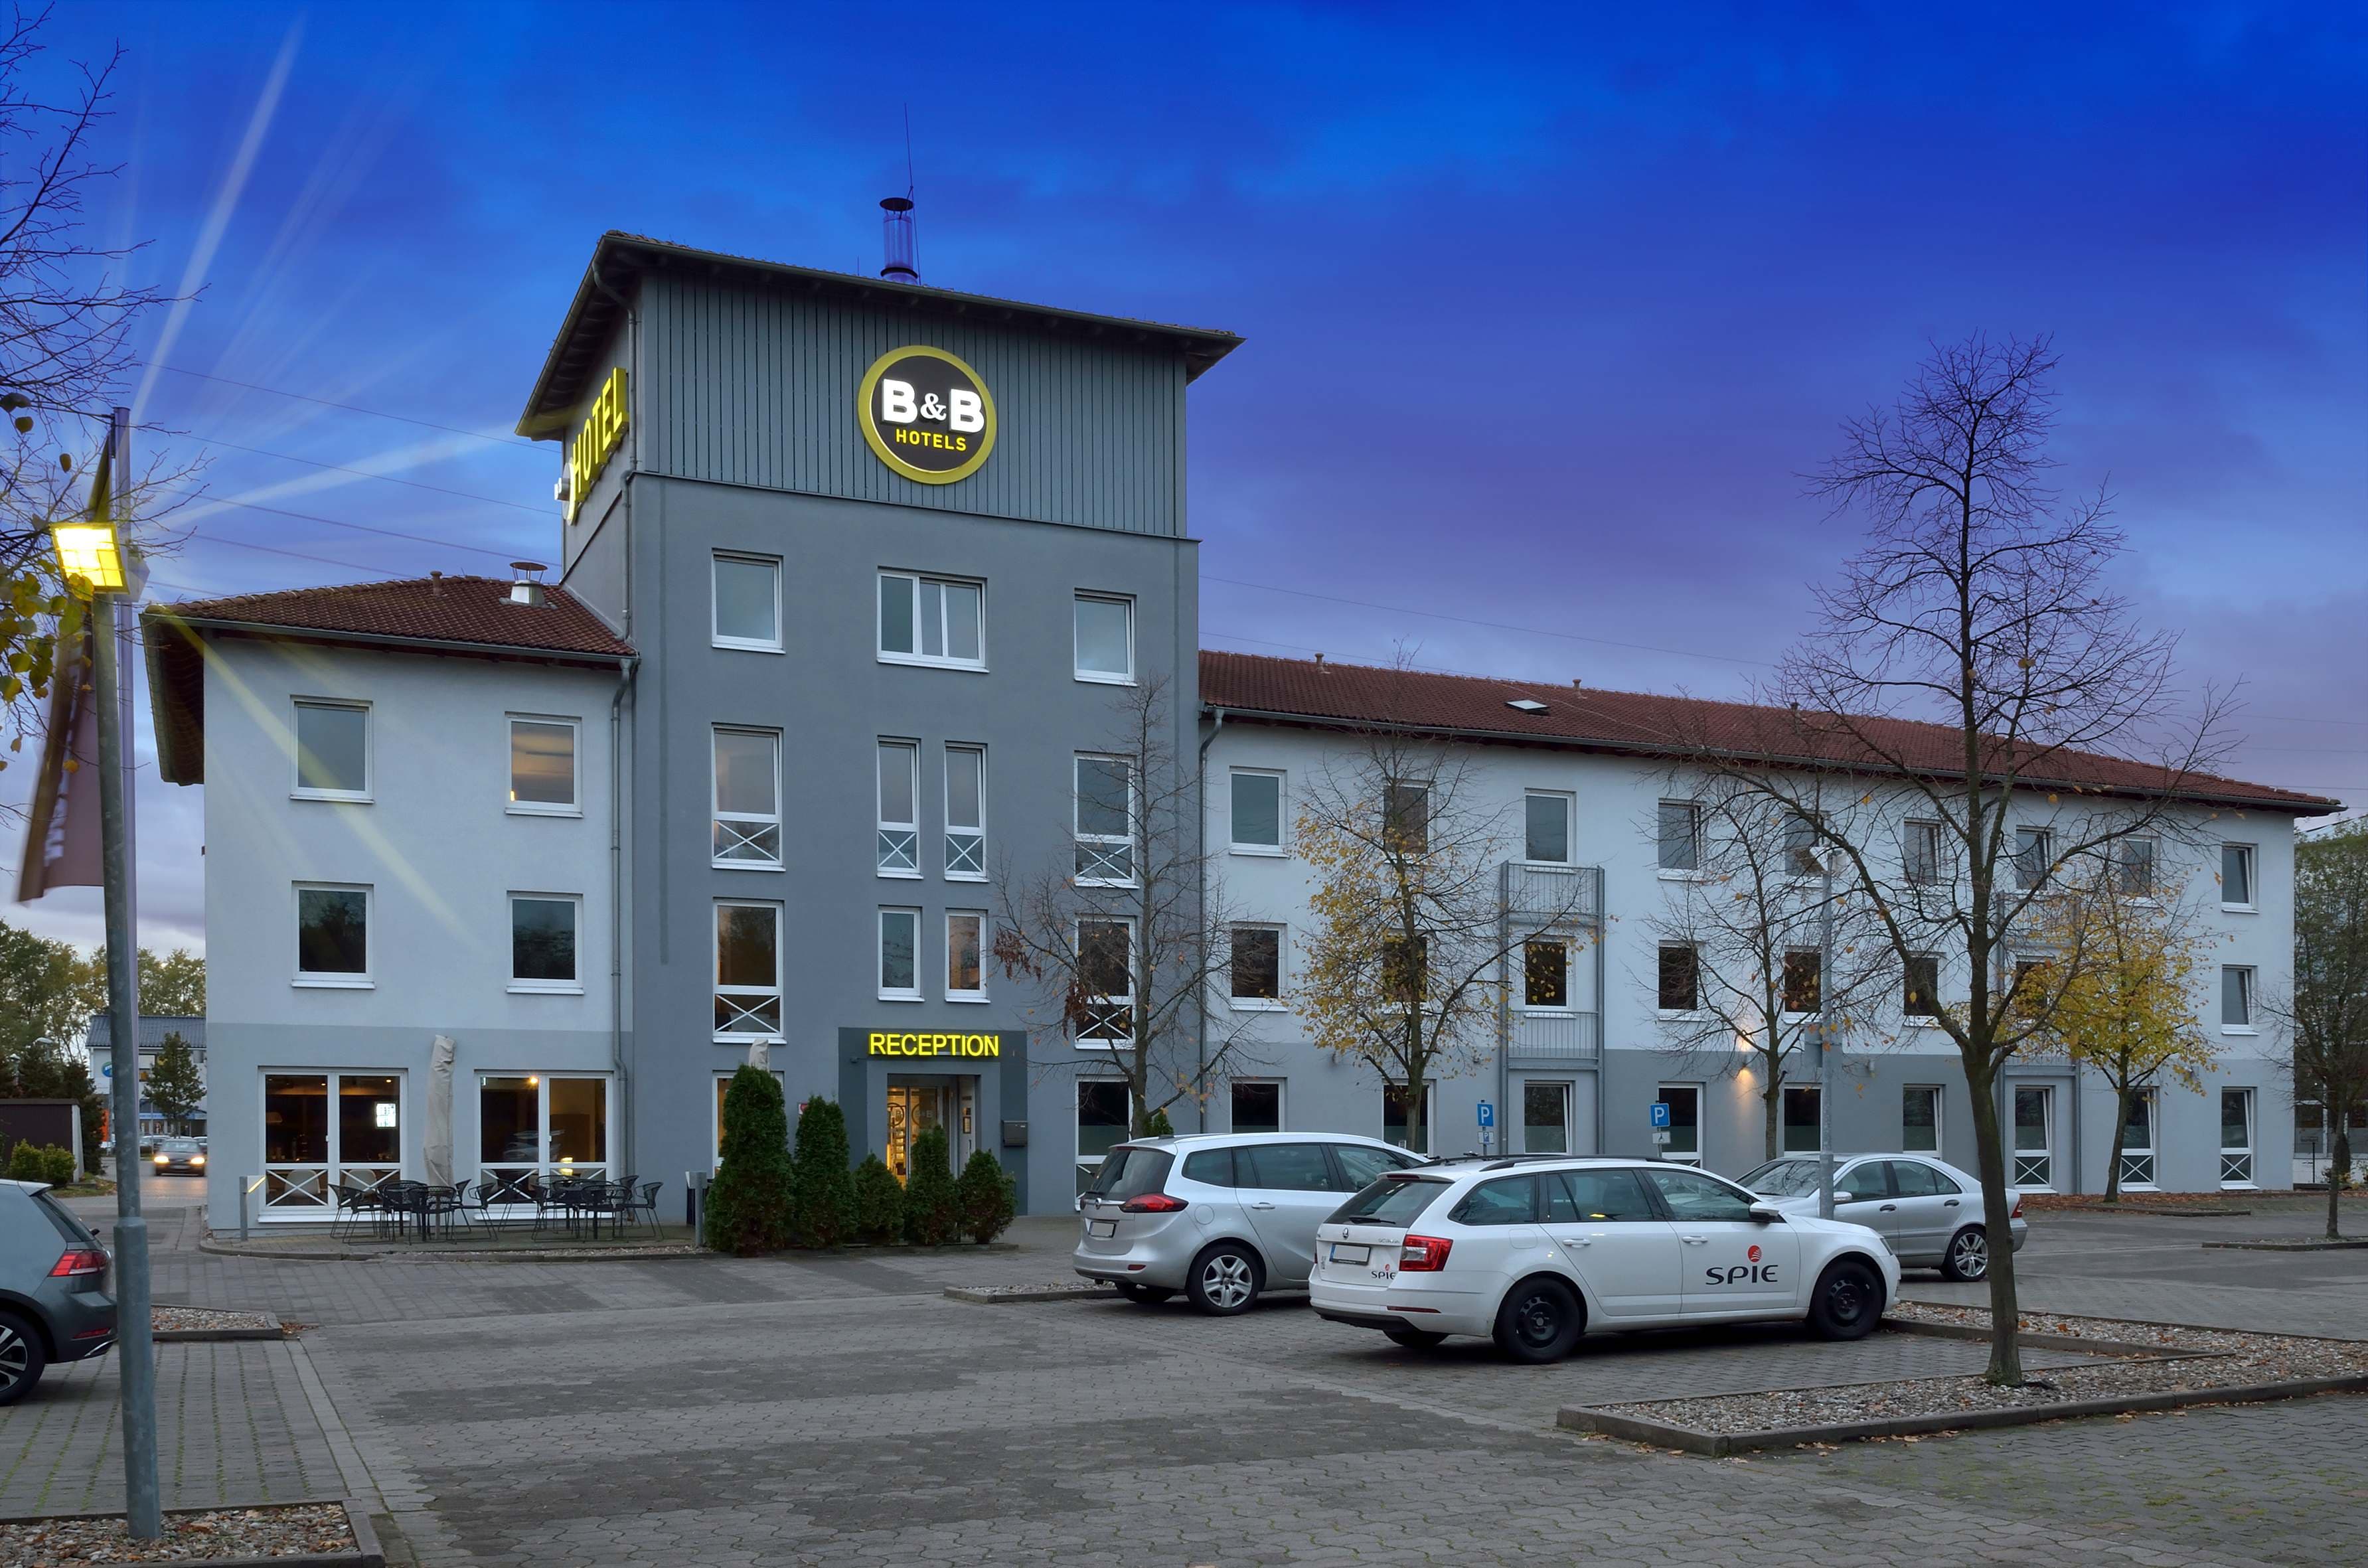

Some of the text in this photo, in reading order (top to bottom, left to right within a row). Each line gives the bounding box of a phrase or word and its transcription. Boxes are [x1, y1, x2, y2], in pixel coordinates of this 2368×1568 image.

[882, 378, 985, 433] B&B
[573, 367, 624, 502] HOTEL
[896, 429, 967, 452] HOTELS
[868, 1033, 1000, 1057] RECEPTION
[1481, 1106, 1490, 1124] P
[1654, 1107, 1665, 1125] P
[1371, 1270, 1396, 1280] SPIE
[1705, 1265, 1779, 1285] SPIE
